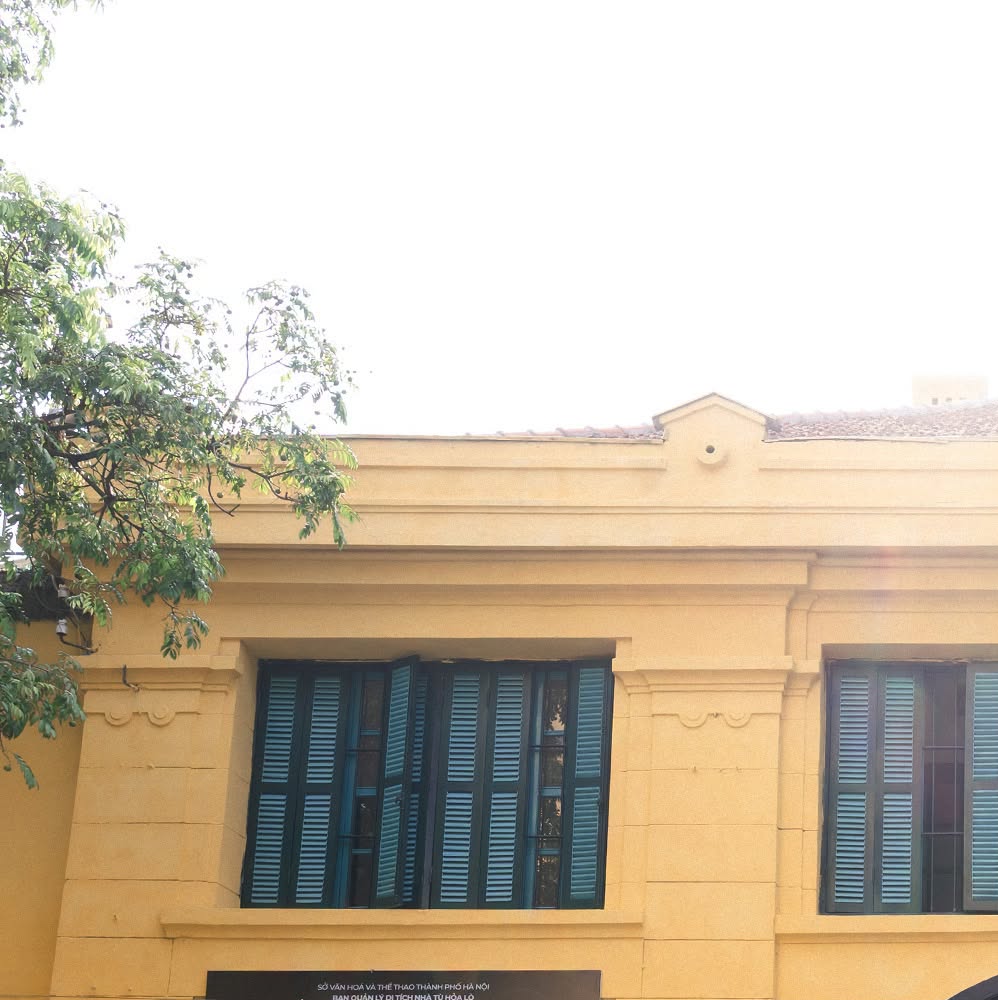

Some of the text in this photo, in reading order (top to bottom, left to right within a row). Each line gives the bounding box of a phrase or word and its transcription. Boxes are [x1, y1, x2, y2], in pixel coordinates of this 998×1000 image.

[329, 983, 346, 991] VĂN
[393, 983, 415, 991] THAO
[416, 982, 443, 991] THÀNH
[463, 982, 475, 991] HÀ
[475, 982, 490, 992] NỘI
[394, 993, 414, 1000] TÍCH
[414, 993, 432, 1000] NHÀ
[433, 993, 444, 1000] TÙ
[463, 993, 475, 1000] LÒ
